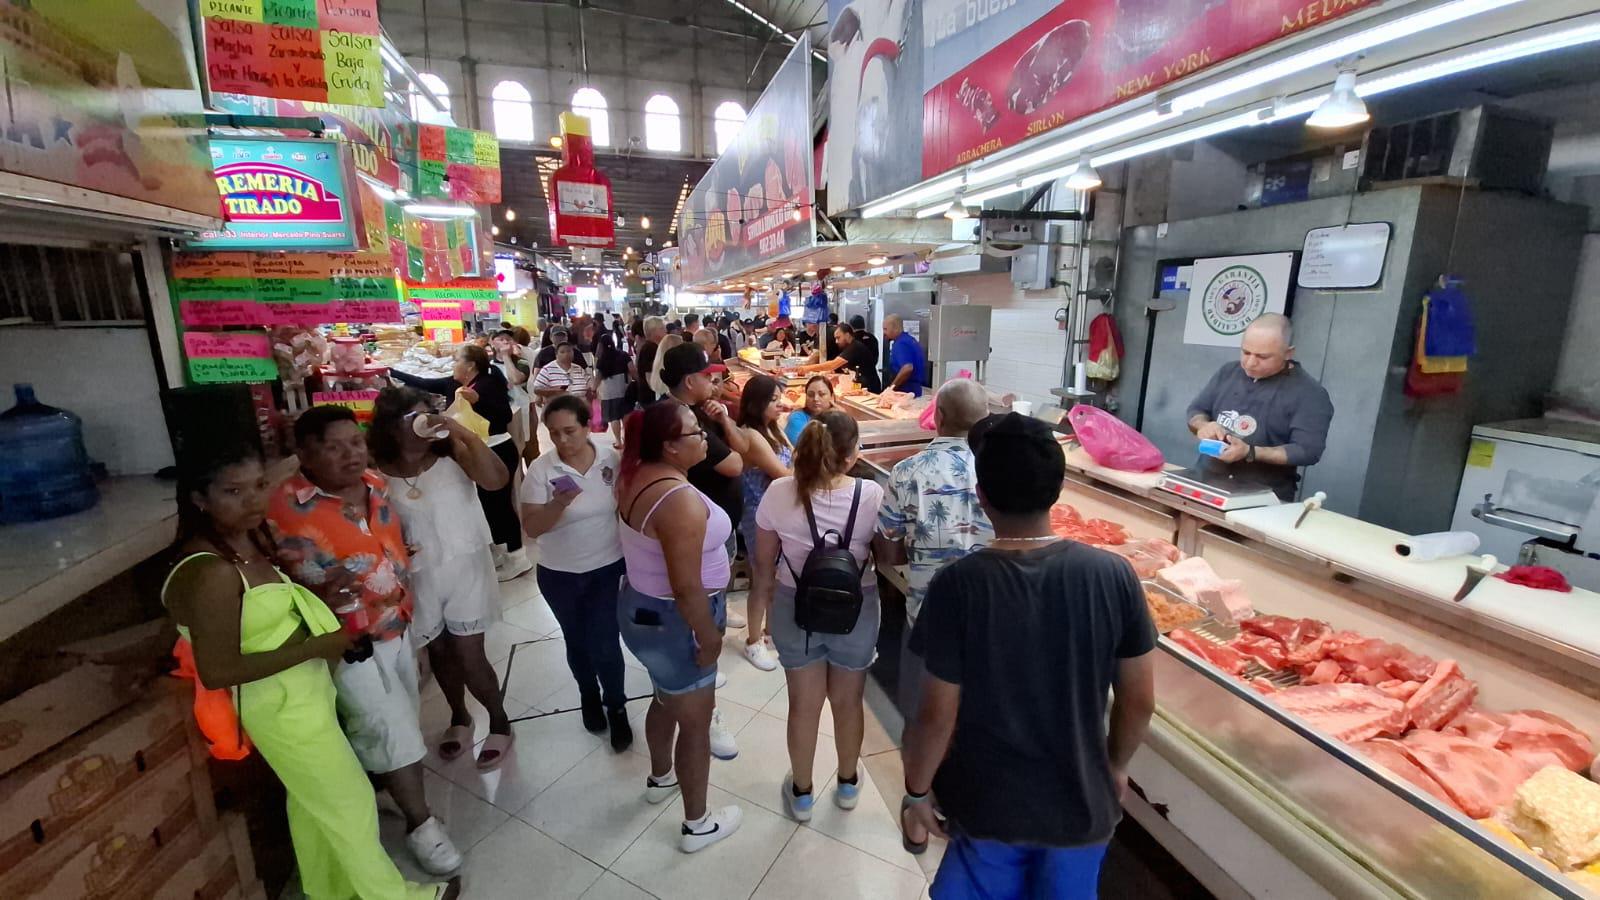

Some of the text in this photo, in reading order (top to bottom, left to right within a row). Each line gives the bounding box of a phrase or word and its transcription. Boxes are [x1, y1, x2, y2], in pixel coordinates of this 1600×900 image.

[208, 15, 253, 35] Salsa
[270, 22, 313, 41] Salsa
[328, 28, 373, 50] Salsa
[335, 52, 365, 73] Baja
[331, 73, 370, 90] Cruda
[1115, 47, 1212, 99] NEW YORK
[957, 138, 1002, 163] ARRACHERA
[215, 173, 320, 202] REMERIA
[225, 198, 303, 215] TIRADO
[272, 231, 303, 239] Mercado
